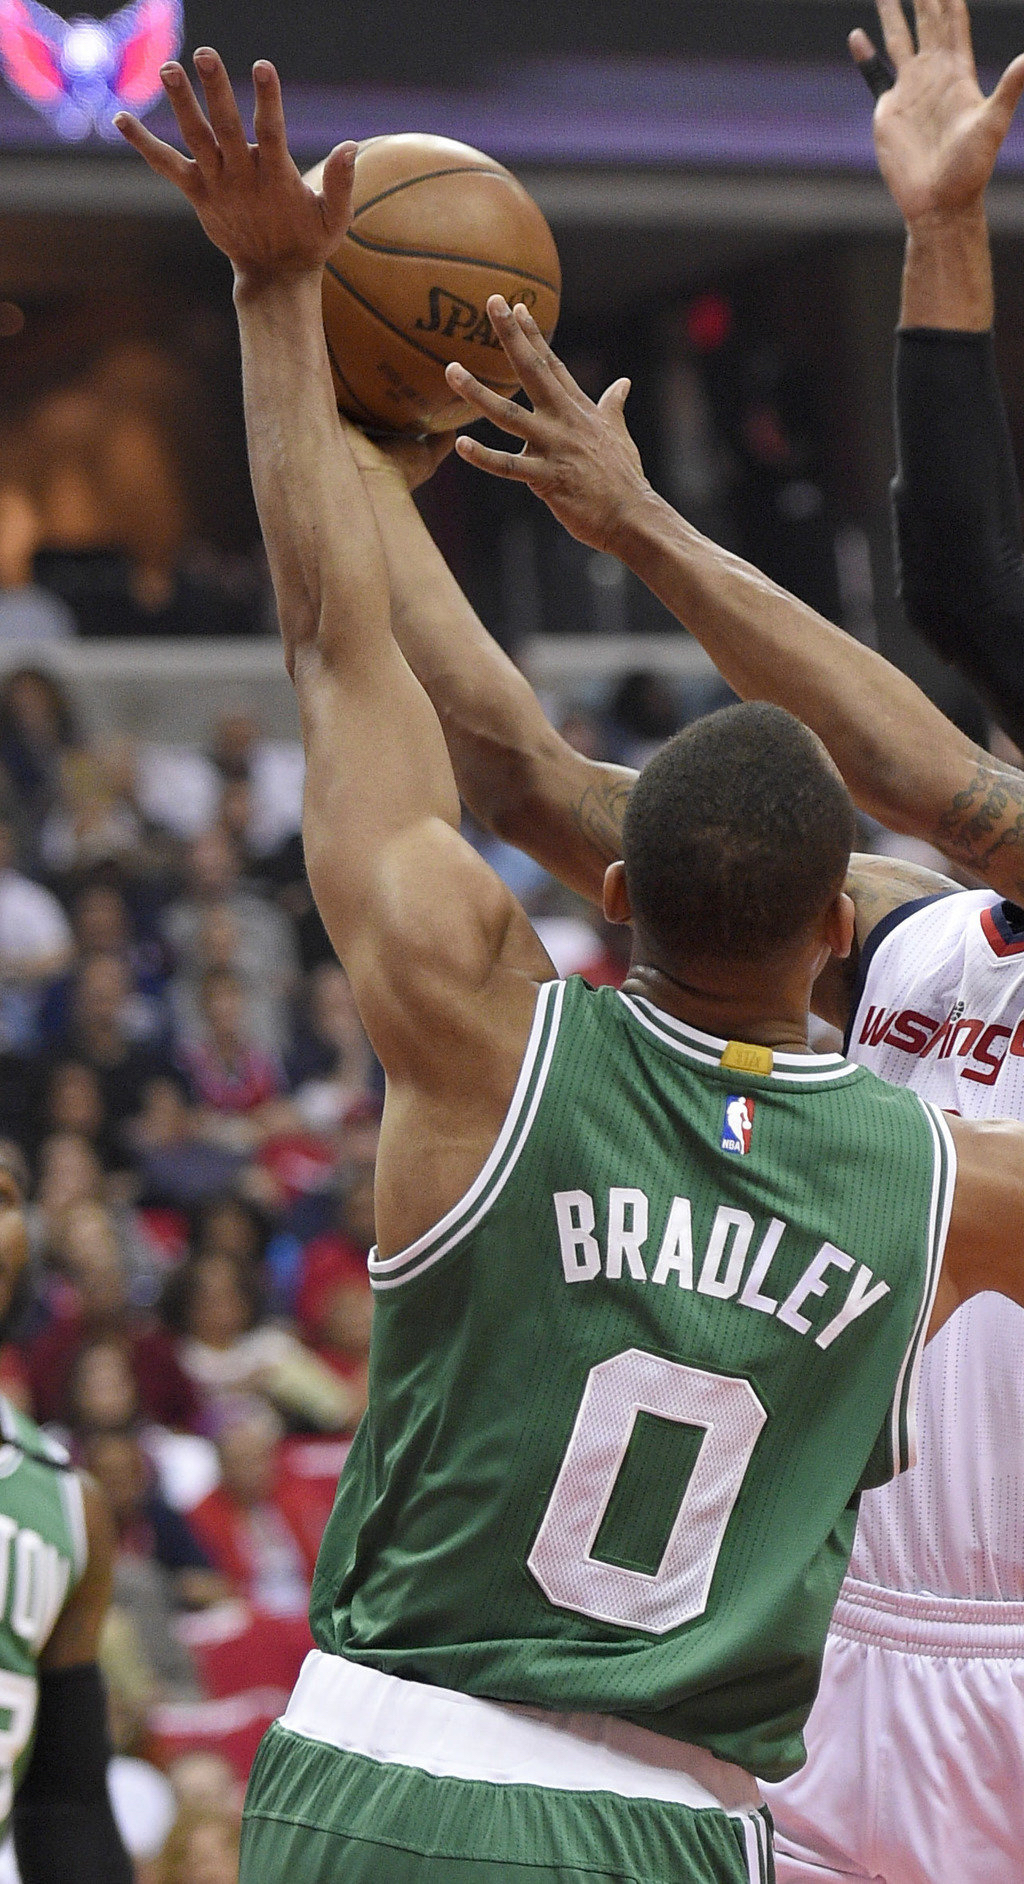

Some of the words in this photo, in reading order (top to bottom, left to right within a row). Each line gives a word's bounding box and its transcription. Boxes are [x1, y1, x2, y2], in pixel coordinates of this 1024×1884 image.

[721, 1138, 741, 1151] NBA
[552, 1187, 891, 1351] BRADLEY
[526, 1347, 769, 1636] 0
